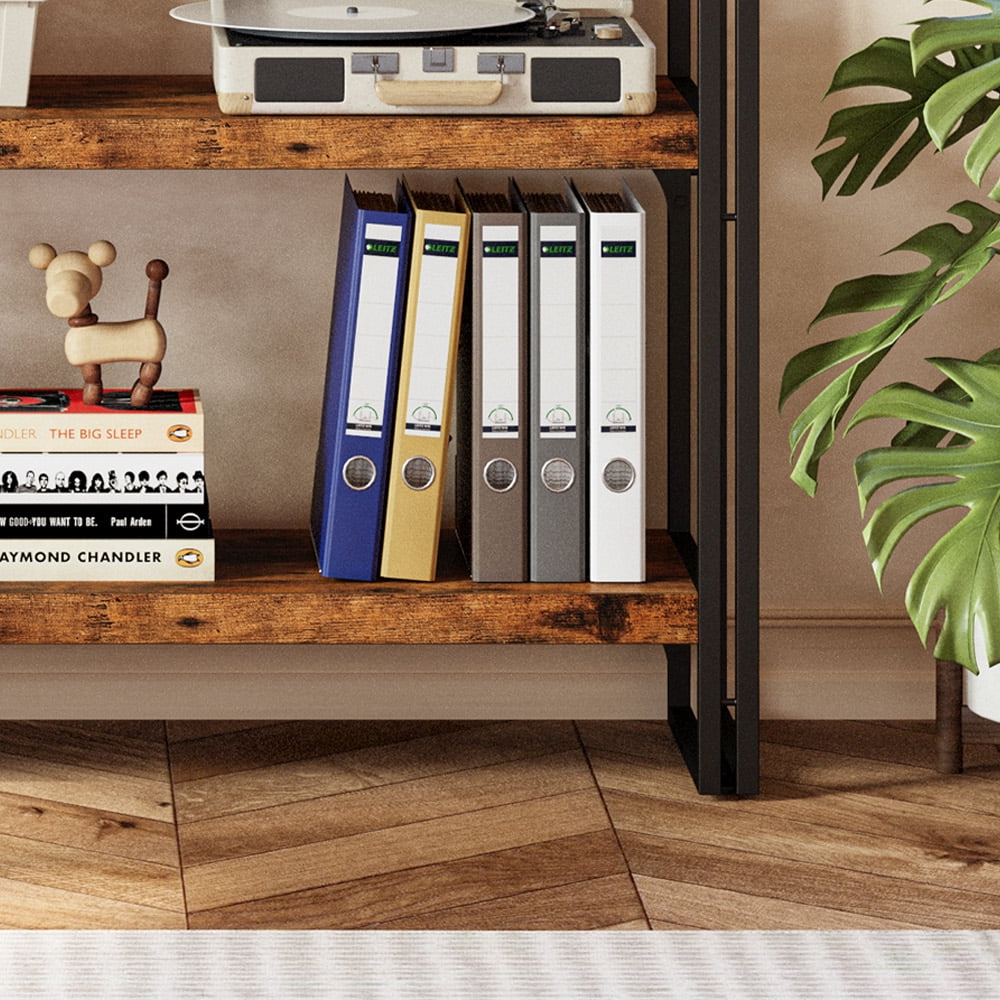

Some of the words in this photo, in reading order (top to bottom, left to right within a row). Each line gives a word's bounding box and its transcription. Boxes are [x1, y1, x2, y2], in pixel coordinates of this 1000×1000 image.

[372, 243, 398, 253] LEITZ
[431, 244, 456, 253] LEITZ
[490, 245, 516, 253] LEITZ
[549, 245, 573, 253] LEITZ
[609, 245, 634, 253] LEITZ
[49, 428, 76, 440] THE
[79, 428, 103, 440] BIG
[106, 428, 143, 440] SLEEP
[49, 516, 71, 527] WANT
[73, 516, 83, 527] TO
[85, 516, 98, 527] BE.
[110, 516, 127, 527] Paul
[130, 516, 152, 527] Arden
[78, 551, 162, 563] CHANDLER
